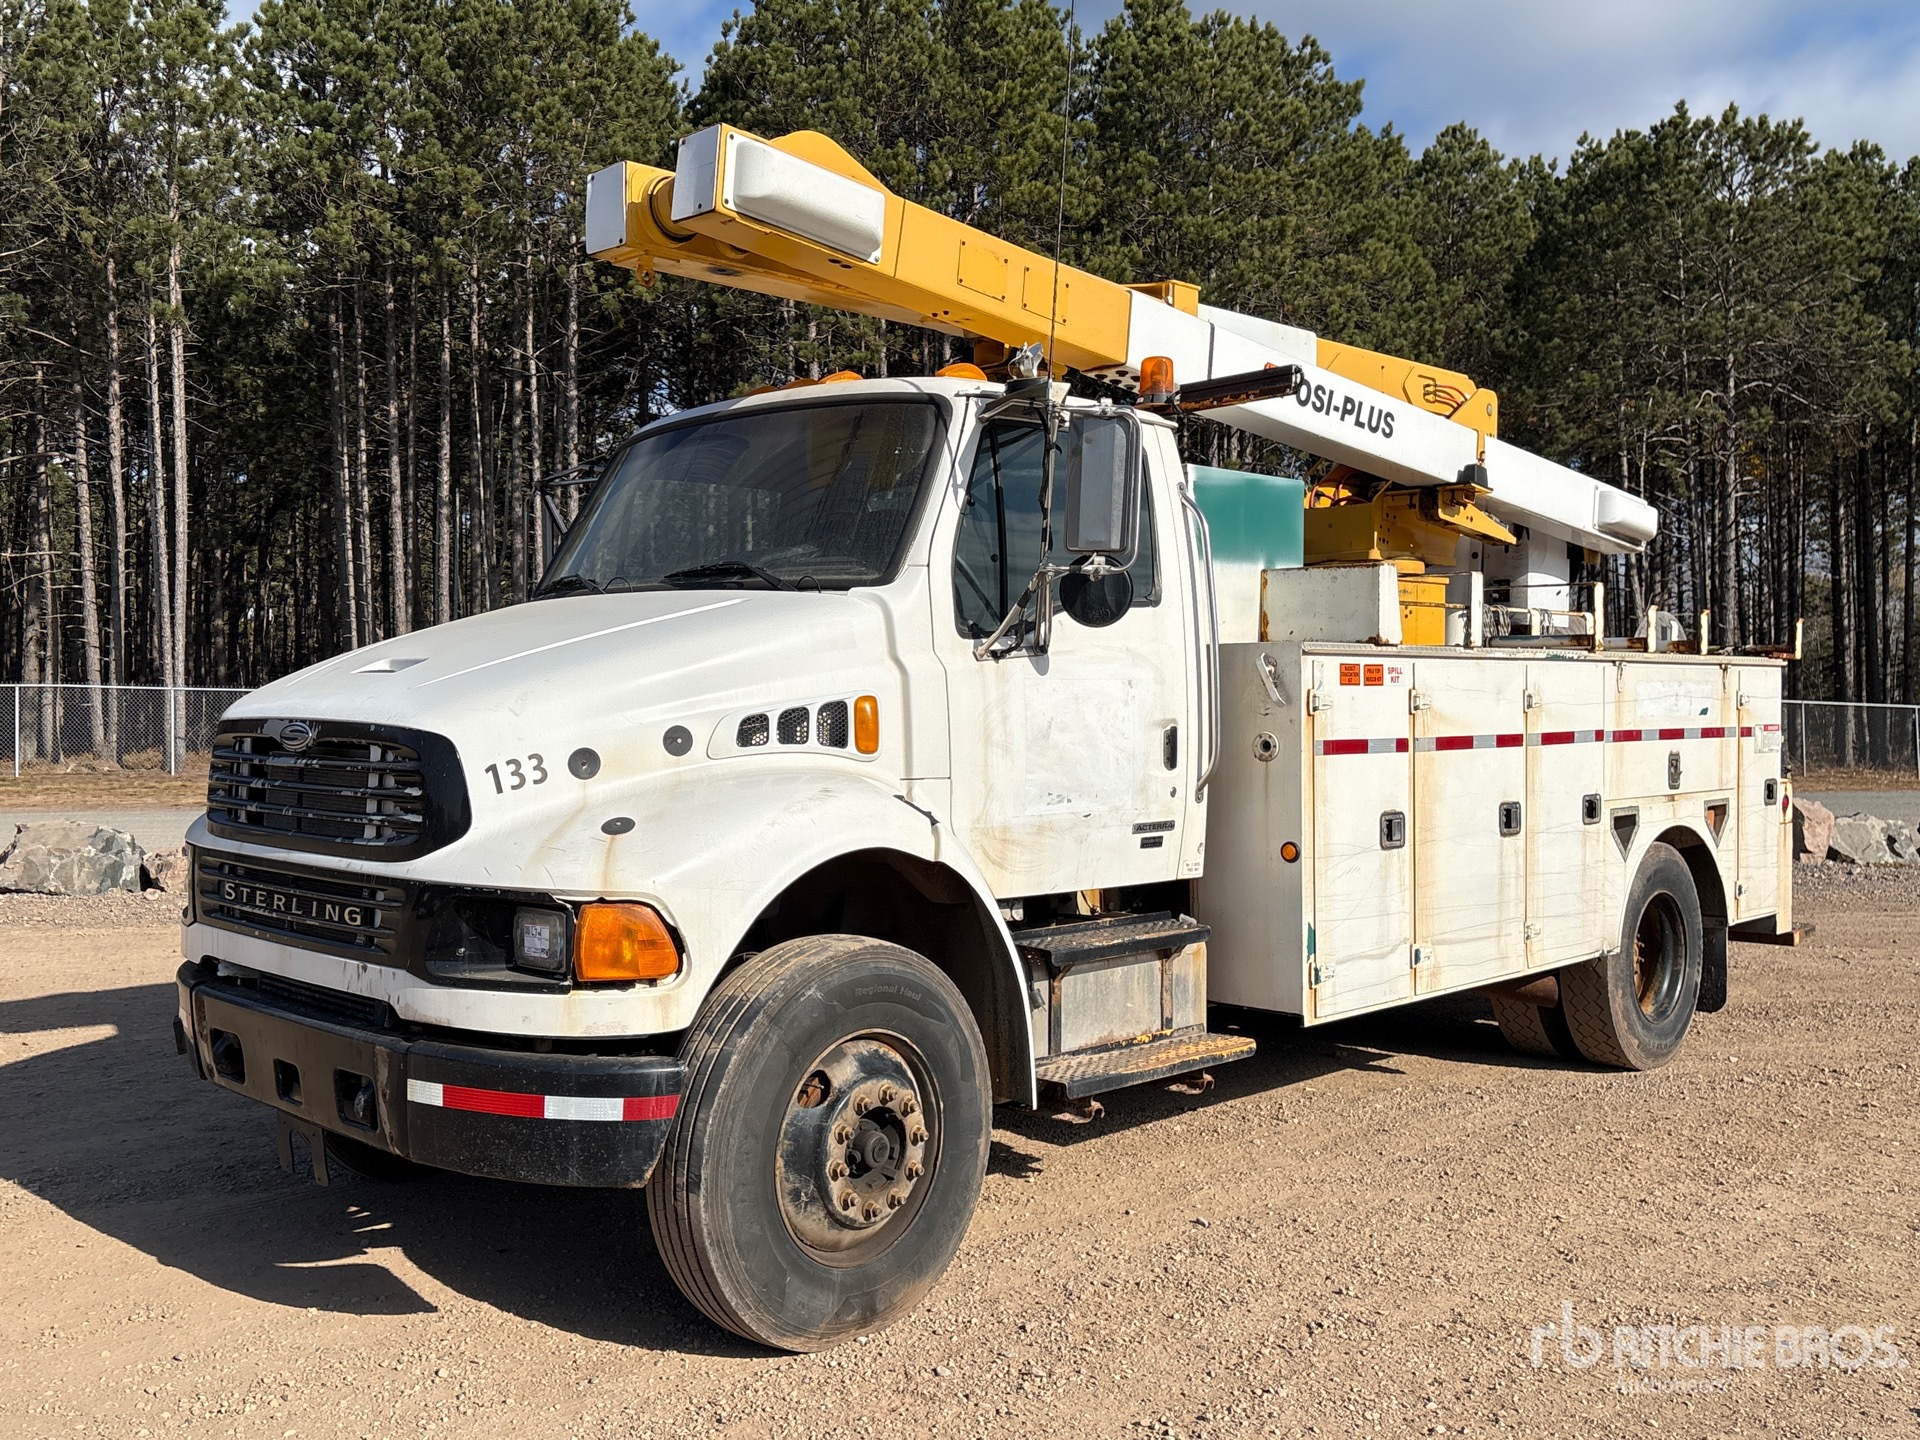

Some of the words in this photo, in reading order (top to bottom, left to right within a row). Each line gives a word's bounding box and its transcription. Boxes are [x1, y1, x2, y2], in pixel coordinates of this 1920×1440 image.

[1295, 379, 1395, 439] OSI-PLUS
[1388, 667, 1403, 675] SPILL
[484, 753, 548, 795] 133
[1136, 822, 1173, 832] ACTERRA
[224, 882, 362, 926] STERLING
[854, 984, 899, 998] Regional
[899, 986, 922, 1001] Haul
